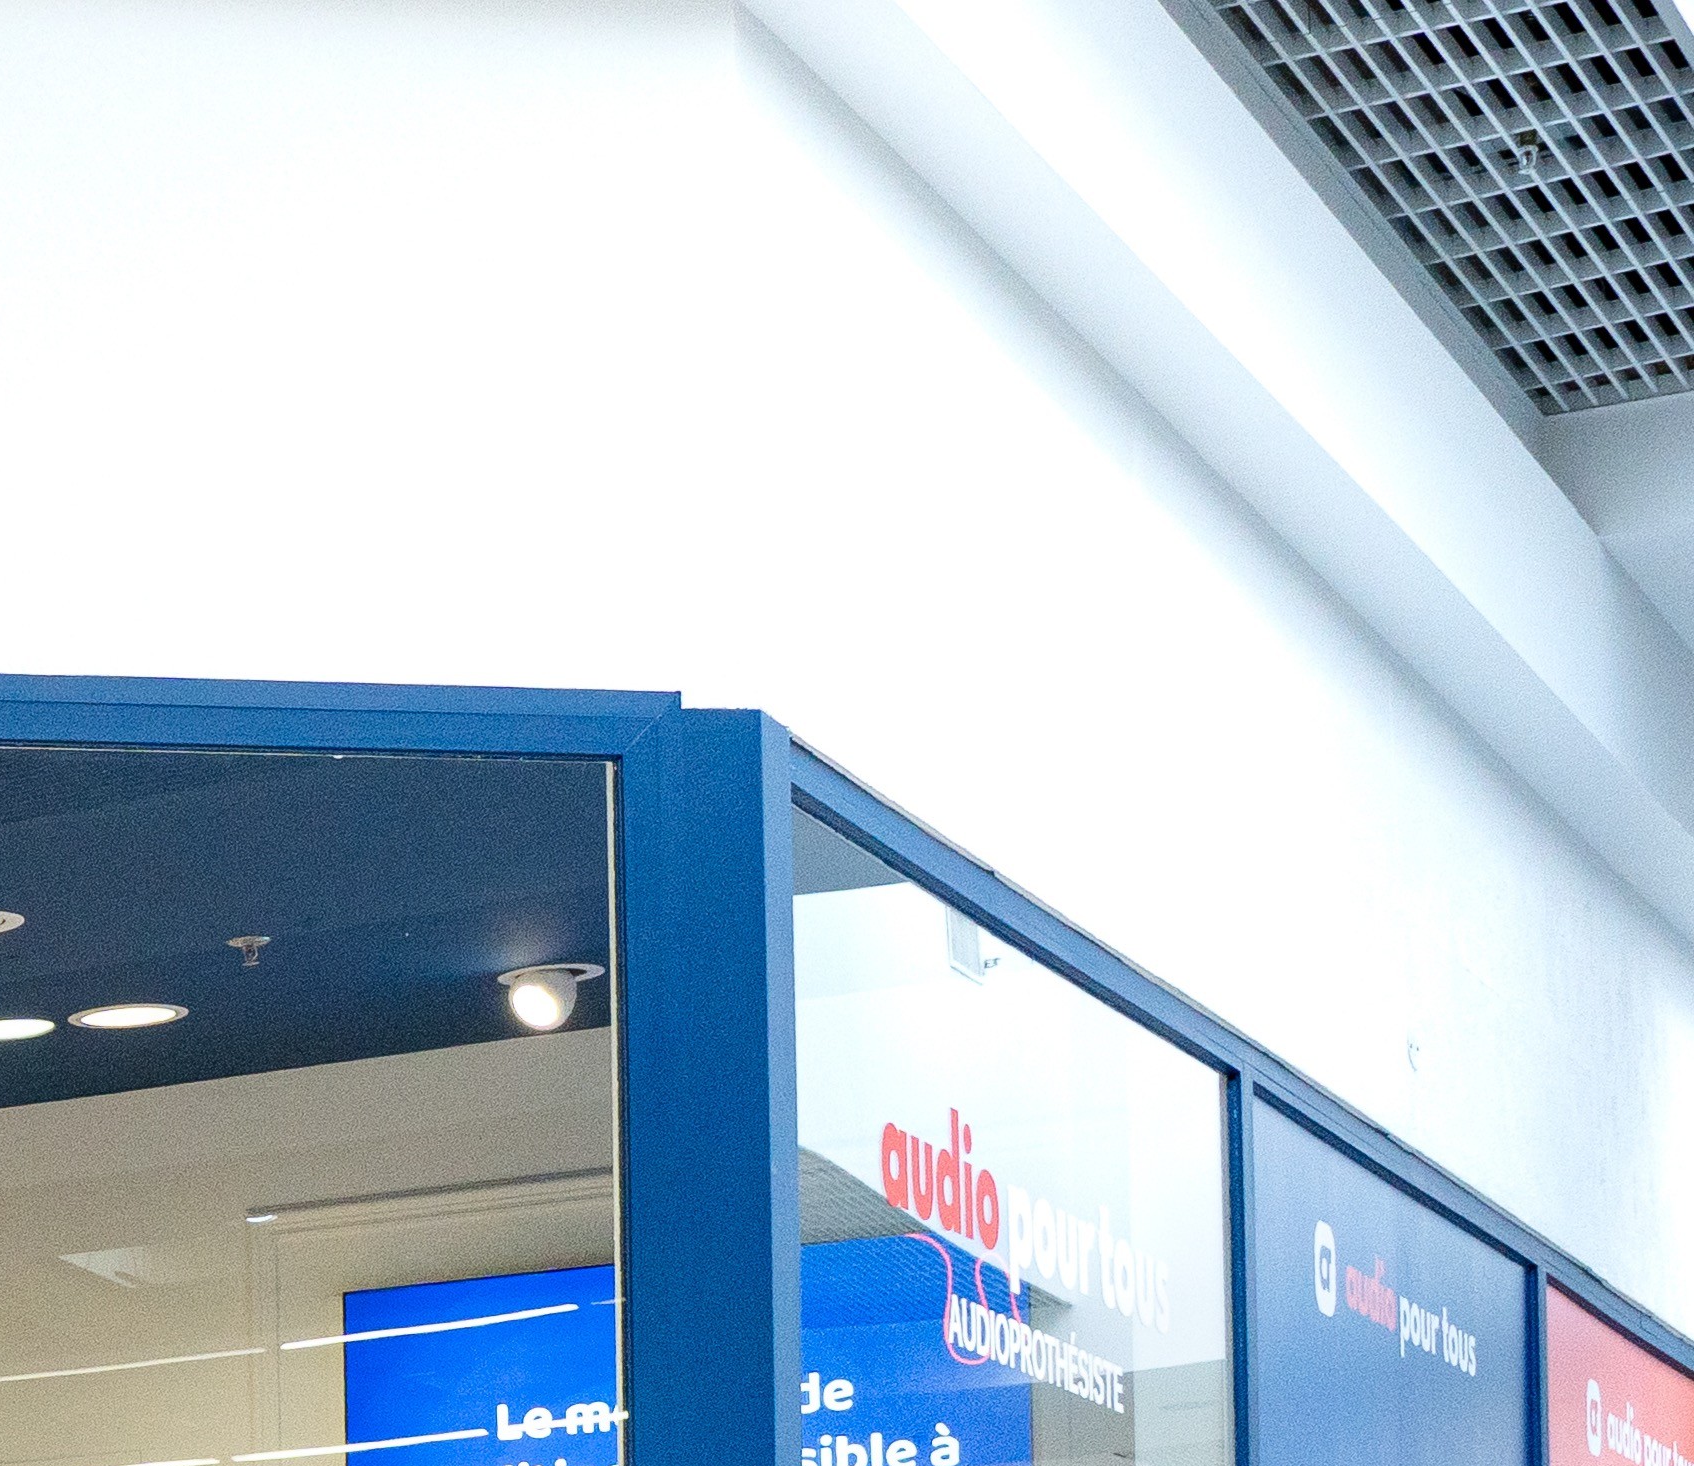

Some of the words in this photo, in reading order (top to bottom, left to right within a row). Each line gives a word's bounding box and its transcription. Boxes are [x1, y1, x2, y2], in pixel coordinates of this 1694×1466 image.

[880, 1107, 1000, 1250] audio
[1007, 1184, 1098, 1296] pour
[1096, 1214, 1170, 1335] tous
[948, 1293, 1125, 1414] AUDIOPROTHÉSISTE
[1345, 1256, 1396, 1332] audio
[1399, 1296, 1439, 1361] pour
[1441, 1306, 1477, 1377] tous
[496, 1403, 553, 1441] Le
[1606, 1402, 1642, 1465] audio
